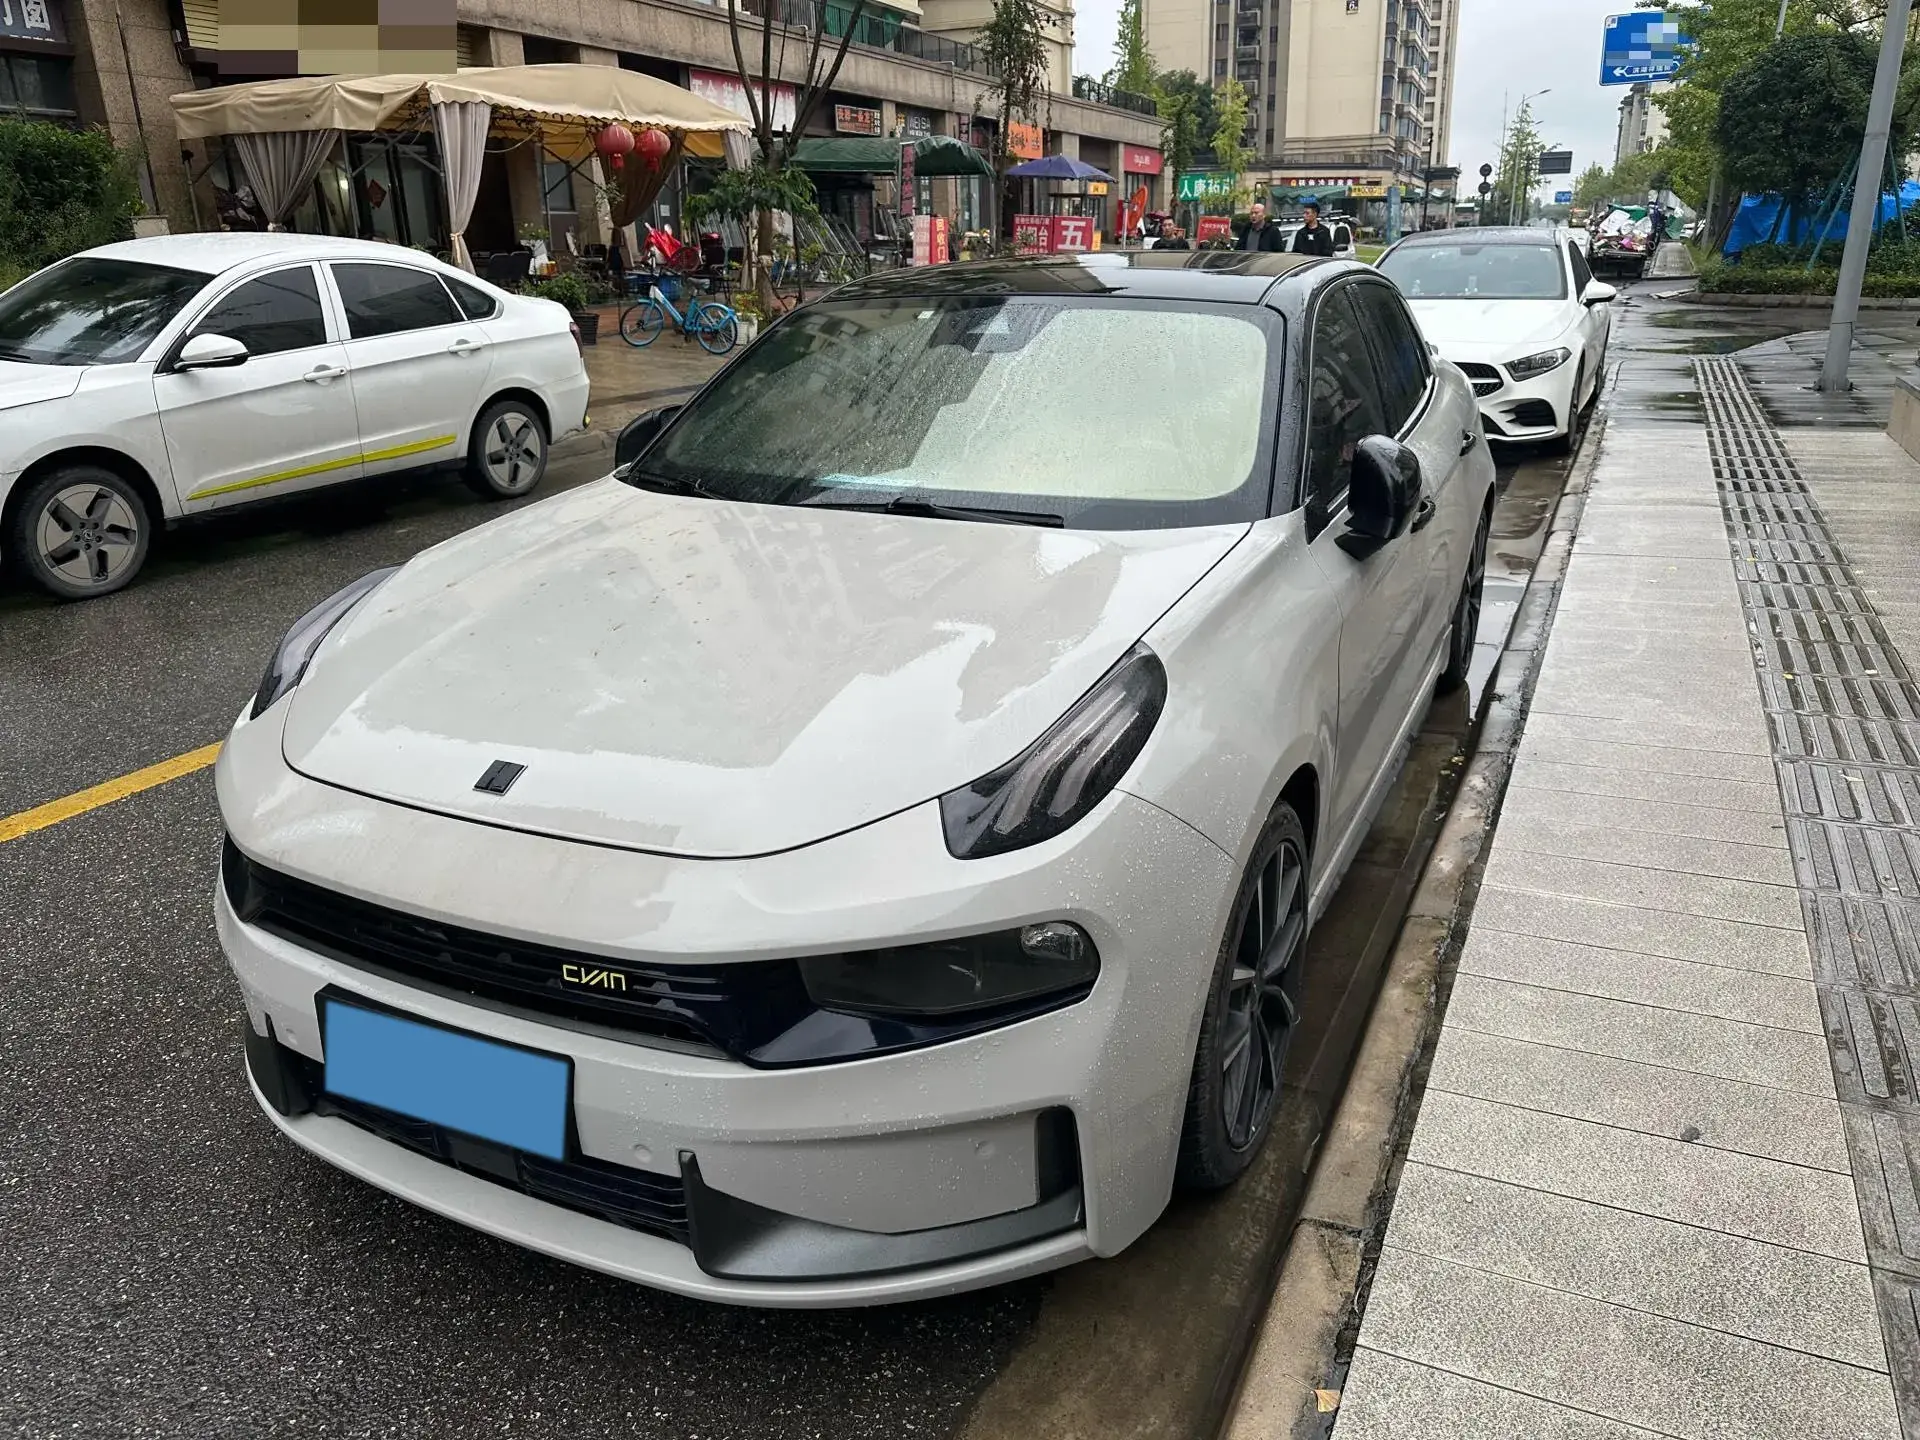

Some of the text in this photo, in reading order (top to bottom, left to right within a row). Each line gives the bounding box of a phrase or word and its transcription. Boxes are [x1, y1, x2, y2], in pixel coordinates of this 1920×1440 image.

[936, 218, 946, 264] 回收门
[1057, 220, 1087, 251] 五
